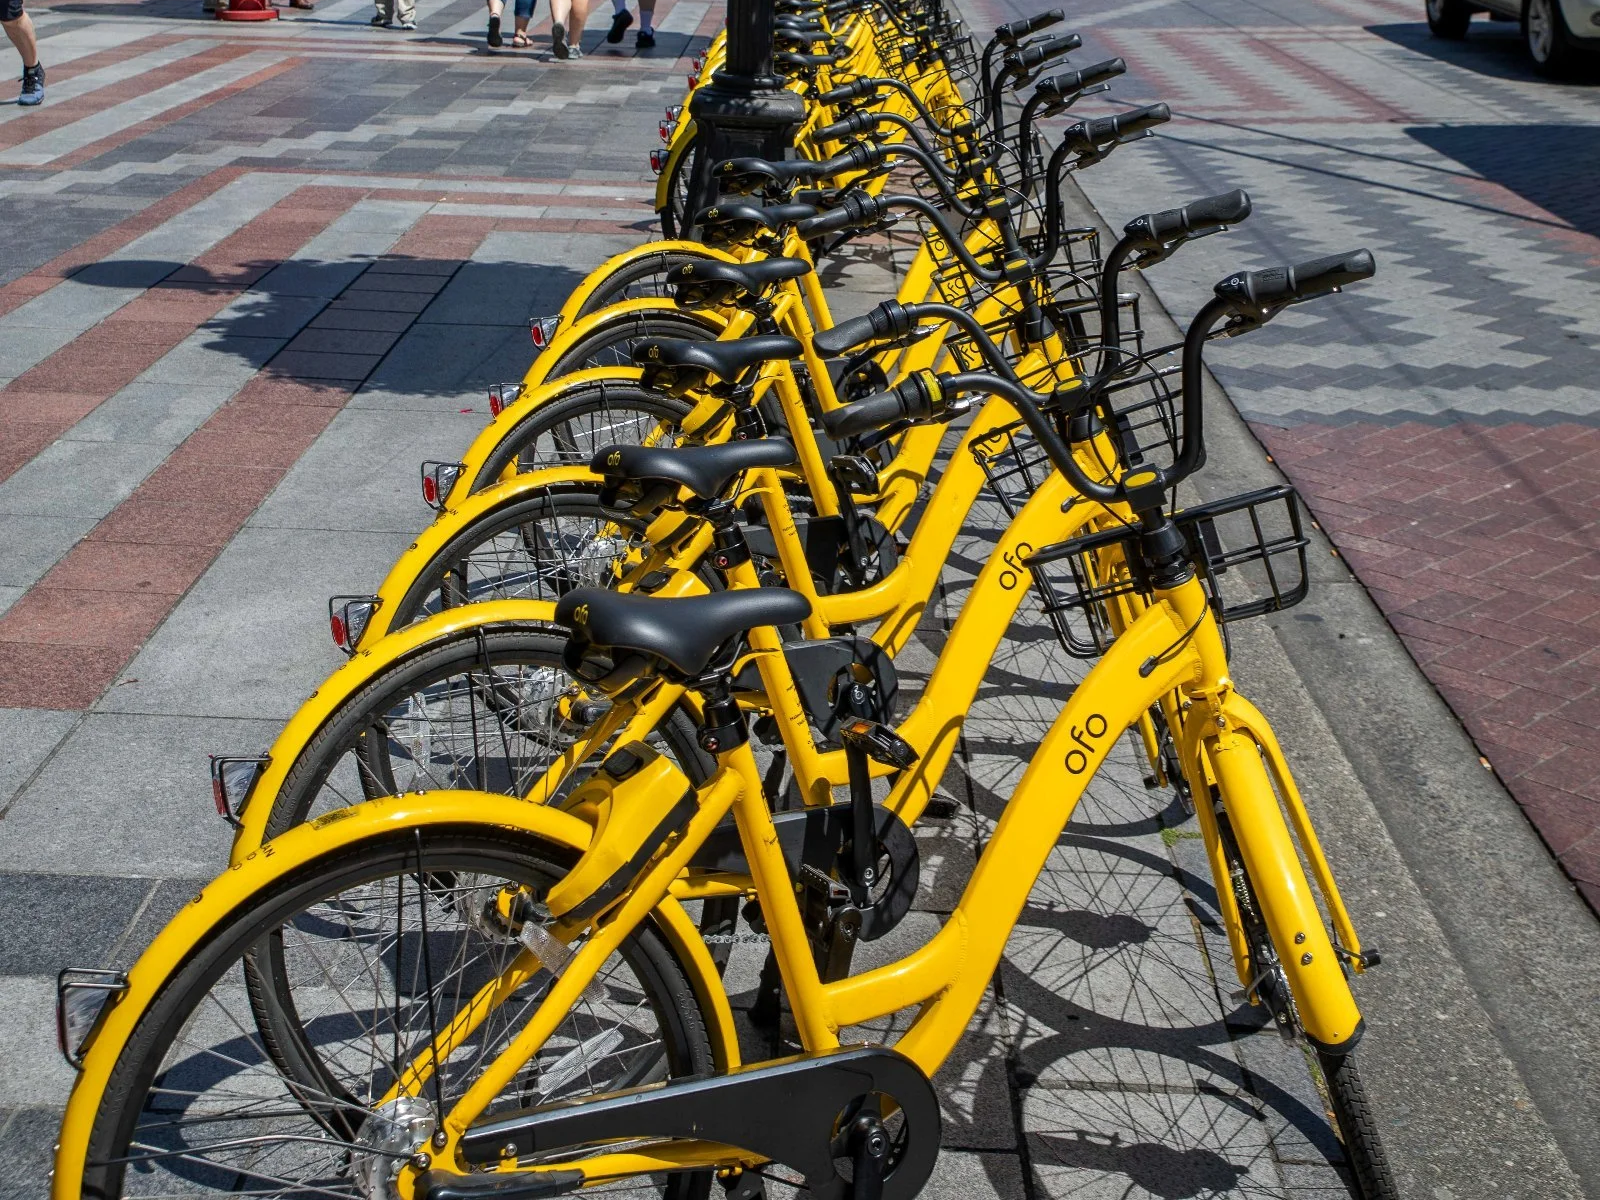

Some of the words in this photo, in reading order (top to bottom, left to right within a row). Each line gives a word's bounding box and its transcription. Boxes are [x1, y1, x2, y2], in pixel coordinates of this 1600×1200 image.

[607, 450, 621, 466] ofo
[999, 542, 1033, 590] ofo
[574, 603, 589, 625] ofo
[1065, 713, 1107, 774] ofo
